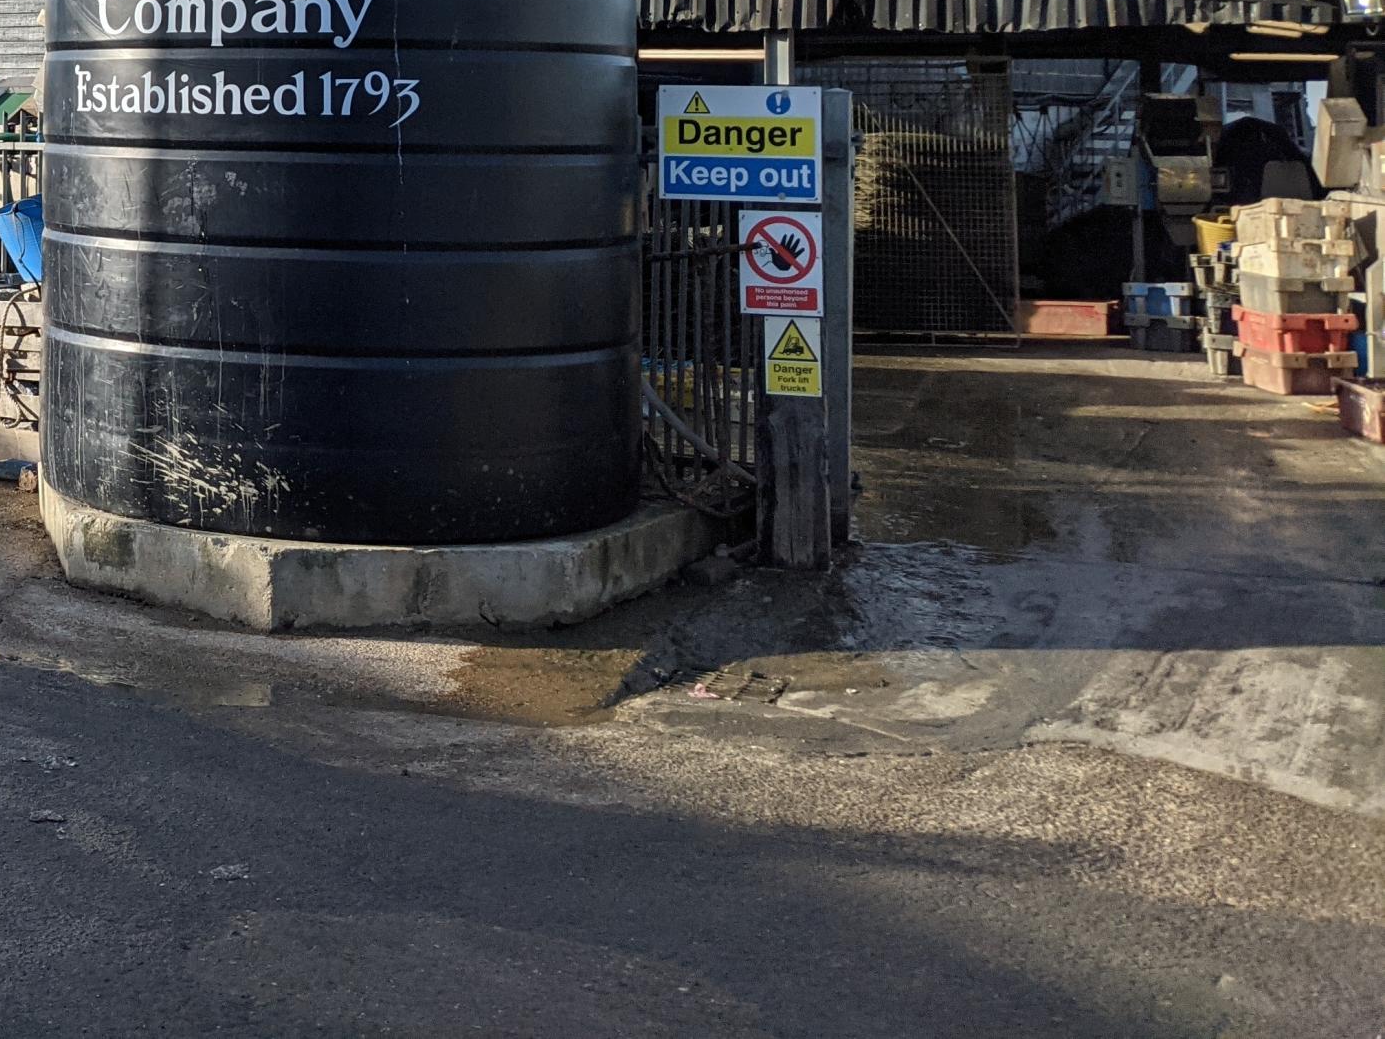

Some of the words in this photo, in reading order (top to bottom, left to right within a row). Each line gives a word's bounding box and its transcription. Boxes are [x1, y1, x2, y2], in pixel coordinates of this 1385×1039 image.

[74, 63, 306, 116] Established
[319, 70, 421, 128] 1793
[678, 119, 803, 154] Danger
[669, 160, 749, 193] Keep
[759, 164, 812, 189] out
[773, 363, 815, 376] Danger
[777, 375, 797, 383] Fork
[780, 384, 807, 392] trucks
